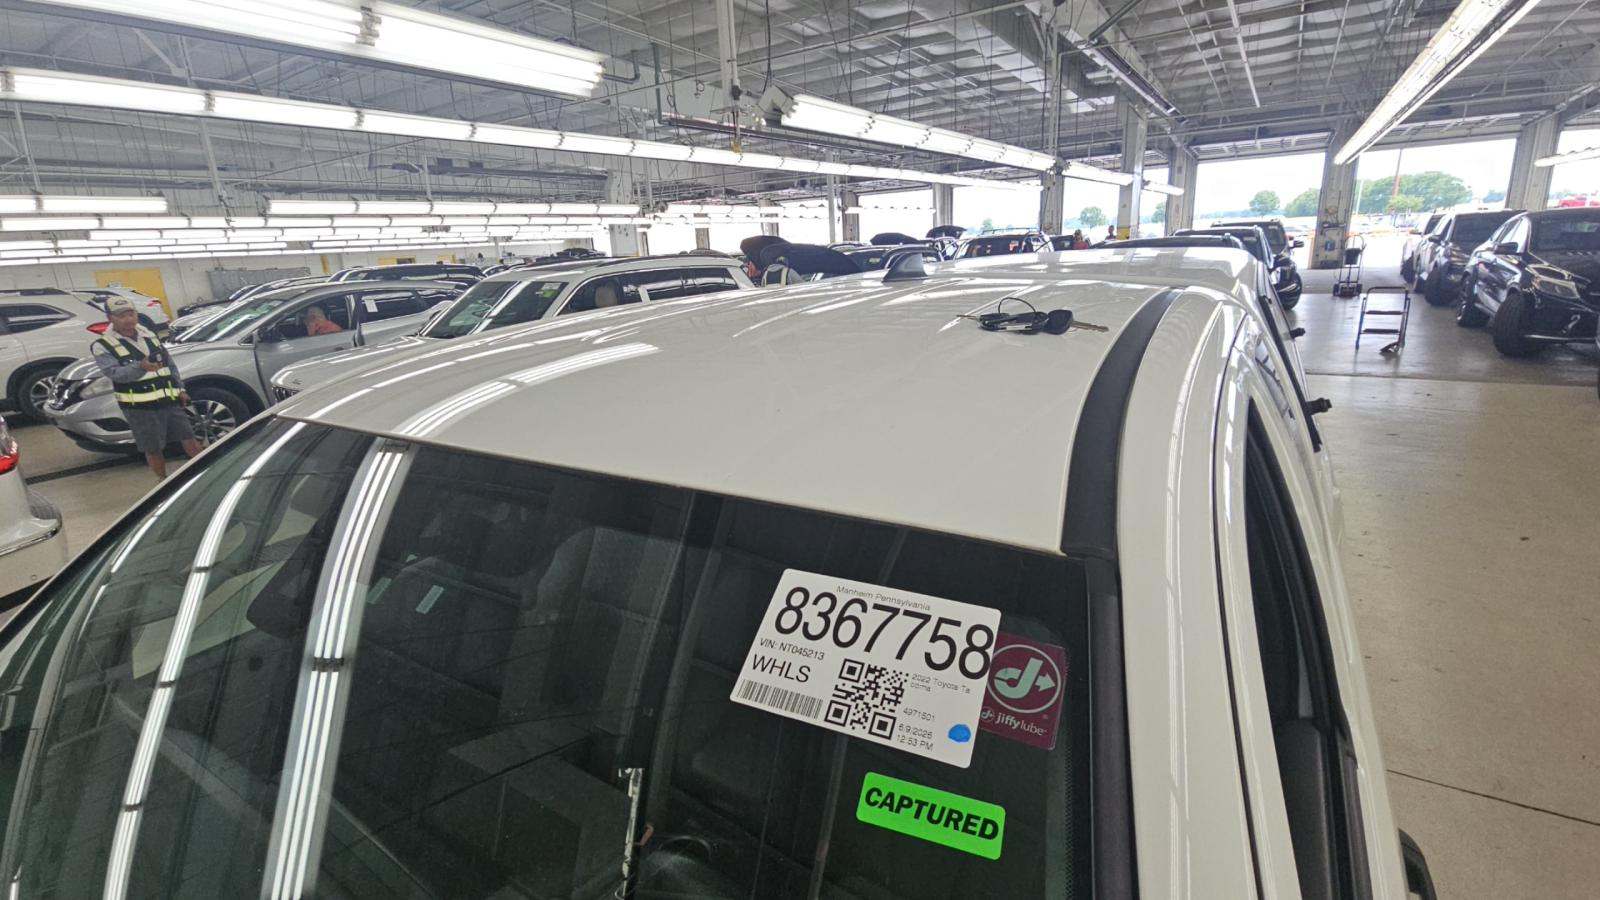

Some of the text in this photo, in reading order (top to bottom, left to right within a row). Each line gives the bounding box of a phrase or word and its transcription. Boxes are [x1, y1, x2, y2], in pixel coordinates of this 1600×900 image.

[836, 585, 930, 611] Manheim Pennsylvania
[775, 586, 994, 680] 8367758
[760, 638, 825, 661] VIN: NT045213
[752, 654, 811, 683] WHLS
[911, 673, 932, 685] 2022
[933, 677, 960, 691] Toyota
[920, 740, 934, 751] PM
[865, 787, 999, 840] CAPTURED
